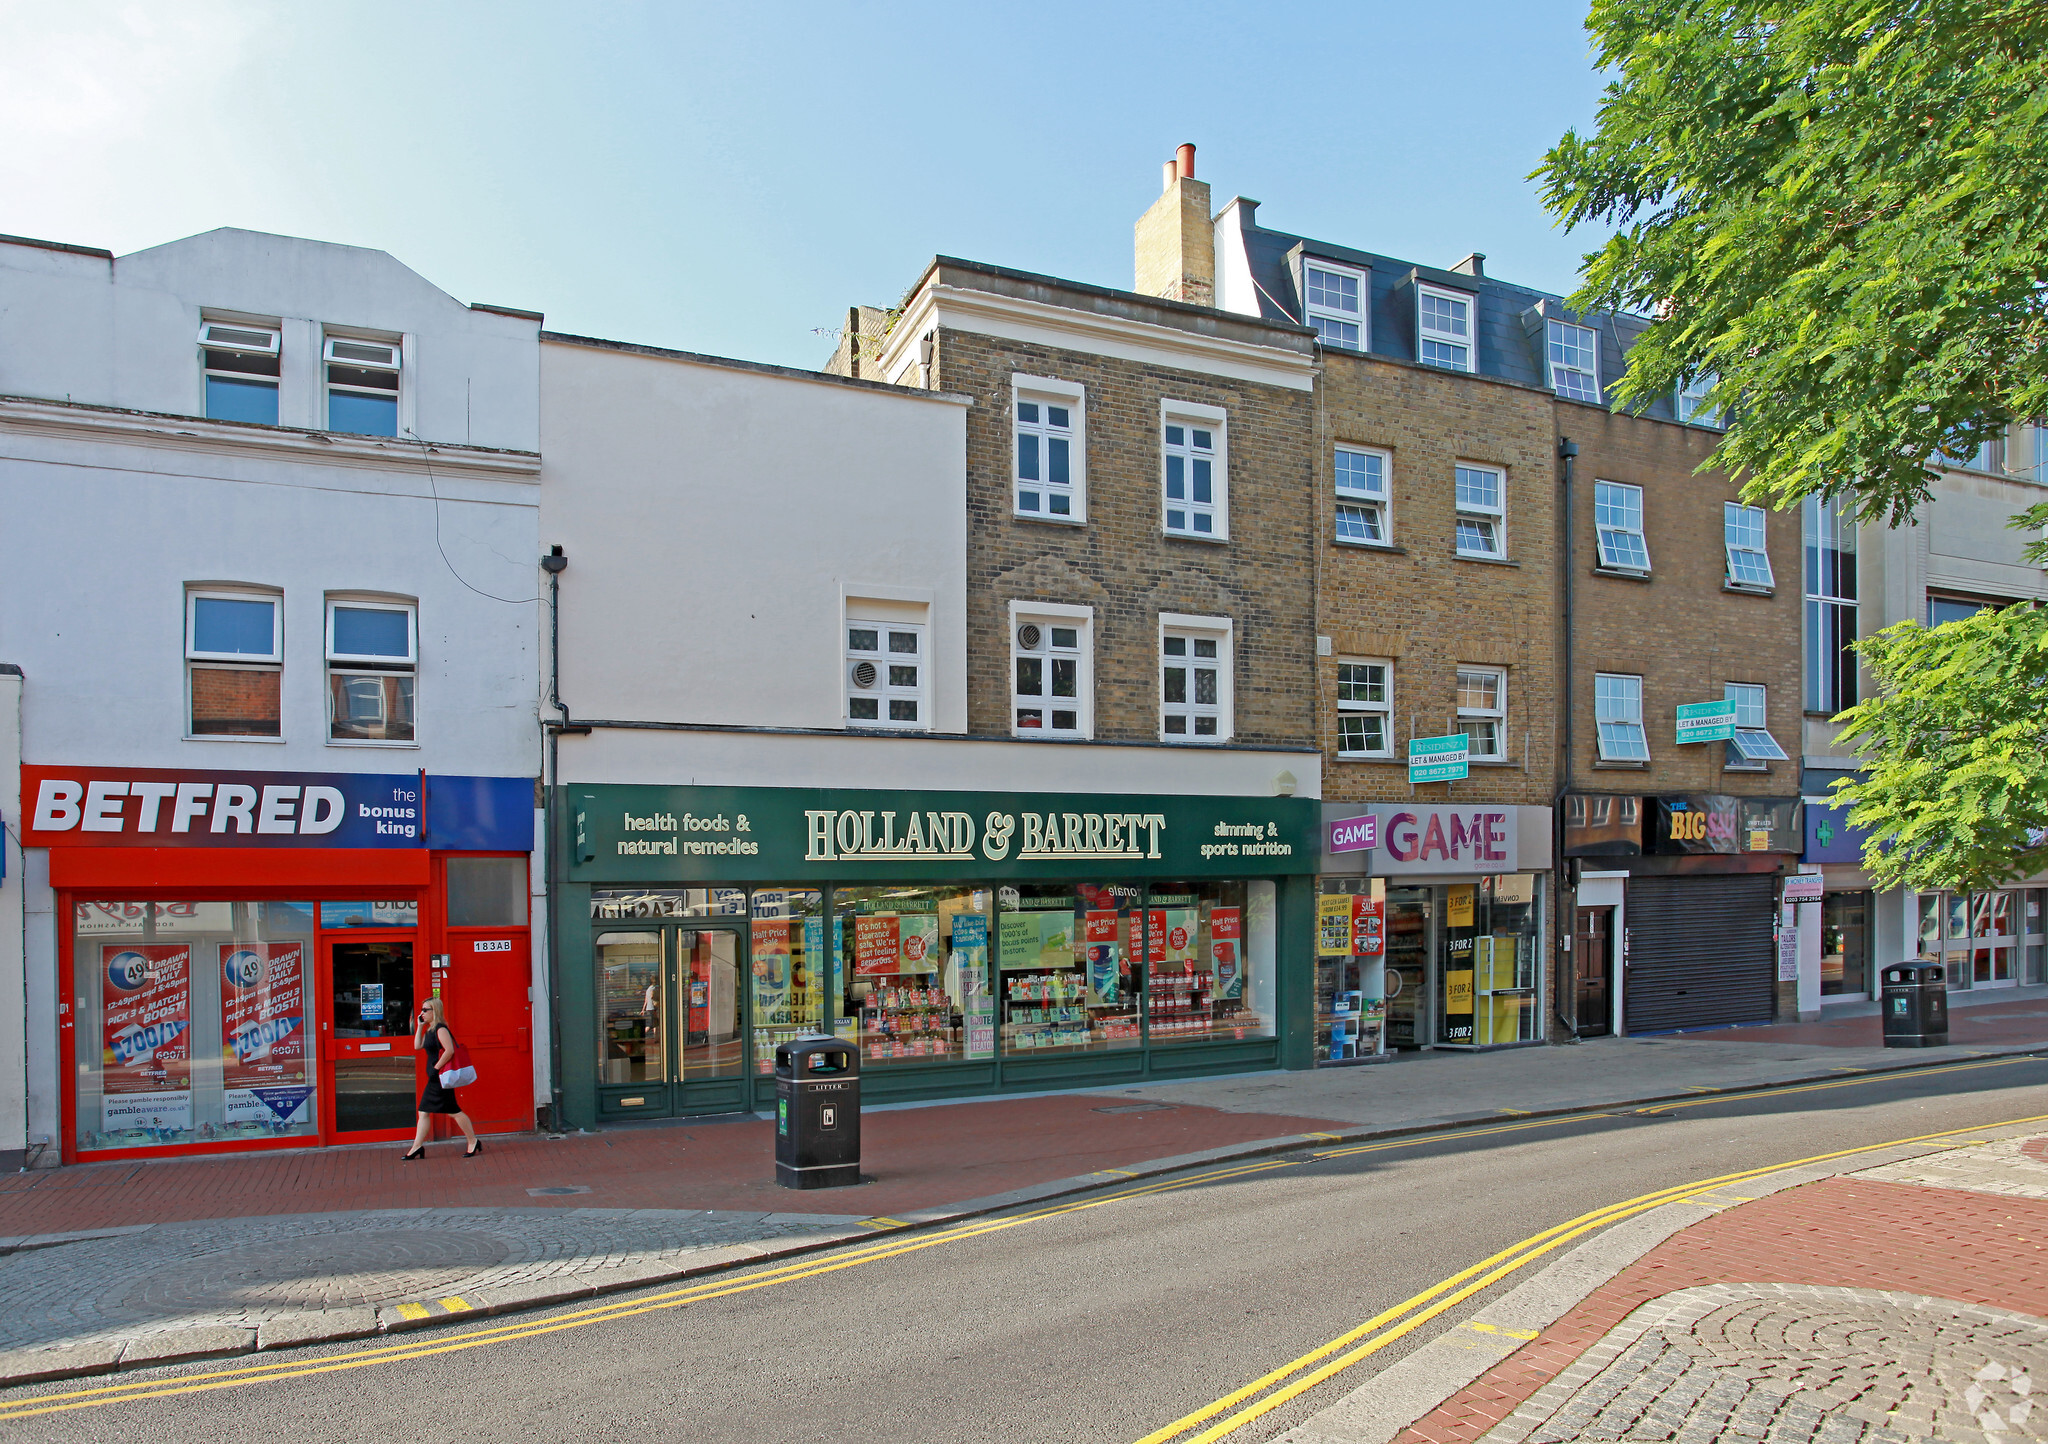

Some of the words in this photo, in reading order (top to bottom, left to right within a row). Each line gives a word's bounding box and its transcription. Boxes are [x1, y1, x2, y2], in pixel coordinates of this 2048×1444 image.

[1696, 717, 1724, 726] MANAGED
[1416, 741, 1464, 752] RESIDENZA
[1428, 754, 1458, 763] MANAGED
[393, 788, 416, 802] the
[32, 779, 346, 835] BETFRED
[359, 804, 416, 818] bonus
[1670, 802, 1688, 810] THE
[376, 820, 416, 838] king
[624, 812, 678, 831] health
[682, 812, 730, 832] foods
[736, 814, 751, 832] &
[1670, 812, 1706, 840] BIG
[804, 809, 976, 861] HOLLAND
[982, 811, 1016, 861] &
[1020, 812, 1166, 859] BARRETT
[1214, 821, 1264, 840] slimming
[1267, 822, 1278, 836] &
[1332, 822, 1374, 846] GAME
[1385, 812, 1506, 862] GAME
[618, 837, 678, 855] natural
[683, 838, 758, 855] remedies
[1200, 842, 1238, 860] sports
[1242, 842, 1292, 856] nutrition
[864, 902, 894, 910] HOLLAND
[902, 901, 930, 910] BARRETT
[1362, 902, 1376, 912] SALE
[1449, 898, 1453, 908] 3
[1454, 896, 1467, 906] FOR
[1468, 894, 1472, 904] 2
[858, 923, 869, 932] It's
[1000, 922, 1026, 930] Discover
[1088, 920, 1100, 928] Half
[1100, 918, 1116, 926] Price
[752, 930, 767, 940] Half
[768, 928, 787, 938] Price
[858, 930, 890, 940] clearance
[1781, 934, 1796, 942] TAILORS
[476, 942, 510, 950] 183AB
[762, 938, 778, 946] Sale
[859, 940, 875, 949] sale.
[876, 938, 896, 946] We're
[1449, 940, 1453, 950] 3
[1454, 939, 1467, 950] FOR
[1468, 938, 1472, 948] 2
[268, 949, 300, 968] DRAWN
[860, 950, 873, 958] just
[874, 947, 896, 956] feeling
[154, 951, 188, 970] DRAWN
[155, 960, 184, 975] TWICE
[268, 958, 296, 974] TWICE
[860, 957, 894, 966] generous.
[154, 970, 180, 986] DAILY
[268, 967, 293, 982] DAILY
[107, 994, 140, 1011] 12:49pm
[142, 986, 156, 998] and
[158, 977, 188, 992] 5:49pm
[225, 992, 256, 1008] 12:49pm
[257, 984, 272, 995] and
[272, 974, 300, 990] 5:49pm
[1448, 986, 1452, 995] 3
[1454, 984, 1466, 994] FOR
[1467, 982, 1472, 992] 2
[108, 1012, 128, 1026] PICK
[130, 1008, 136, 1018] 3
[138, 1006, 146, 1014] &
[147, 992, 180, 1012] MATCH
[180, 990, 188, 999] 3
[143, 999, 186, 1024] BOOST!
[226, 1009, 245, 1023] PICK
[246, 1006, 253, 1014] 3
[254, 1002, 262, 1010] &
[264, 990, 293, 1008] MATCH
[294, 987, 300, 996] 3
[259, 996, 300, 1020] BOOST!
[122, 1022, 174, 1054] 700/1
[240, 1018, 290, 1050] 700/1
[981, 1030, 994, 1040] DAY
[1449, 1028, 1453, 1038] 3
[1454, 1026, 1467, 1038] FOR
[1468, 1026, 1472, 1036] 2
[272, 1046, 300, 1056] 600/1
[972, 1040, 994, 1050] TEATOX
[156, 1050, 186, 1060] 600/1
[129, 1096, 152, 1104] gamble
[153, 1094, 188, 1102] responsibly
